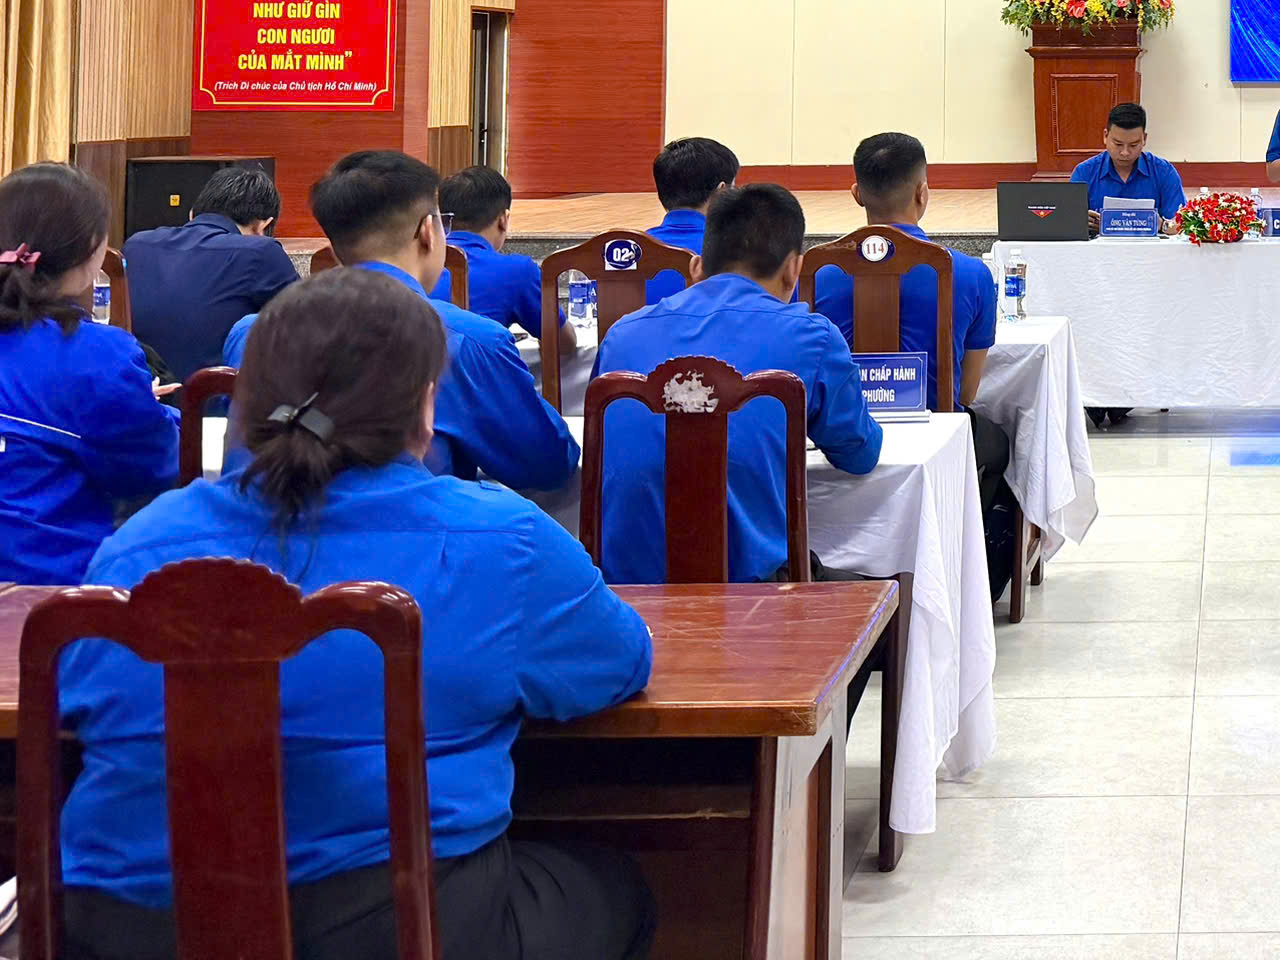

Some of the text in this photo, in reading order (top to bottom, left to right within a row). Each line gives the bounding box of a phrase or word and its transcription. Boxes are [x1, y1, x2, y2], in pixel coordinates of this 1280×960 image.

[254, 0, 340, 19] NHƯ GIỮ GÌN
[258, 28, 286, 44] CON
[238, 50, 267, 69] CỦA
[272, 49, 302, 70] MẮT
[866, 243, 885, 255] 114
[870, 364, 891, 381] CHẤP
[893, 366, 916, 381] HÀNH
[862, 387, 895, 403] PHƯỜNG
